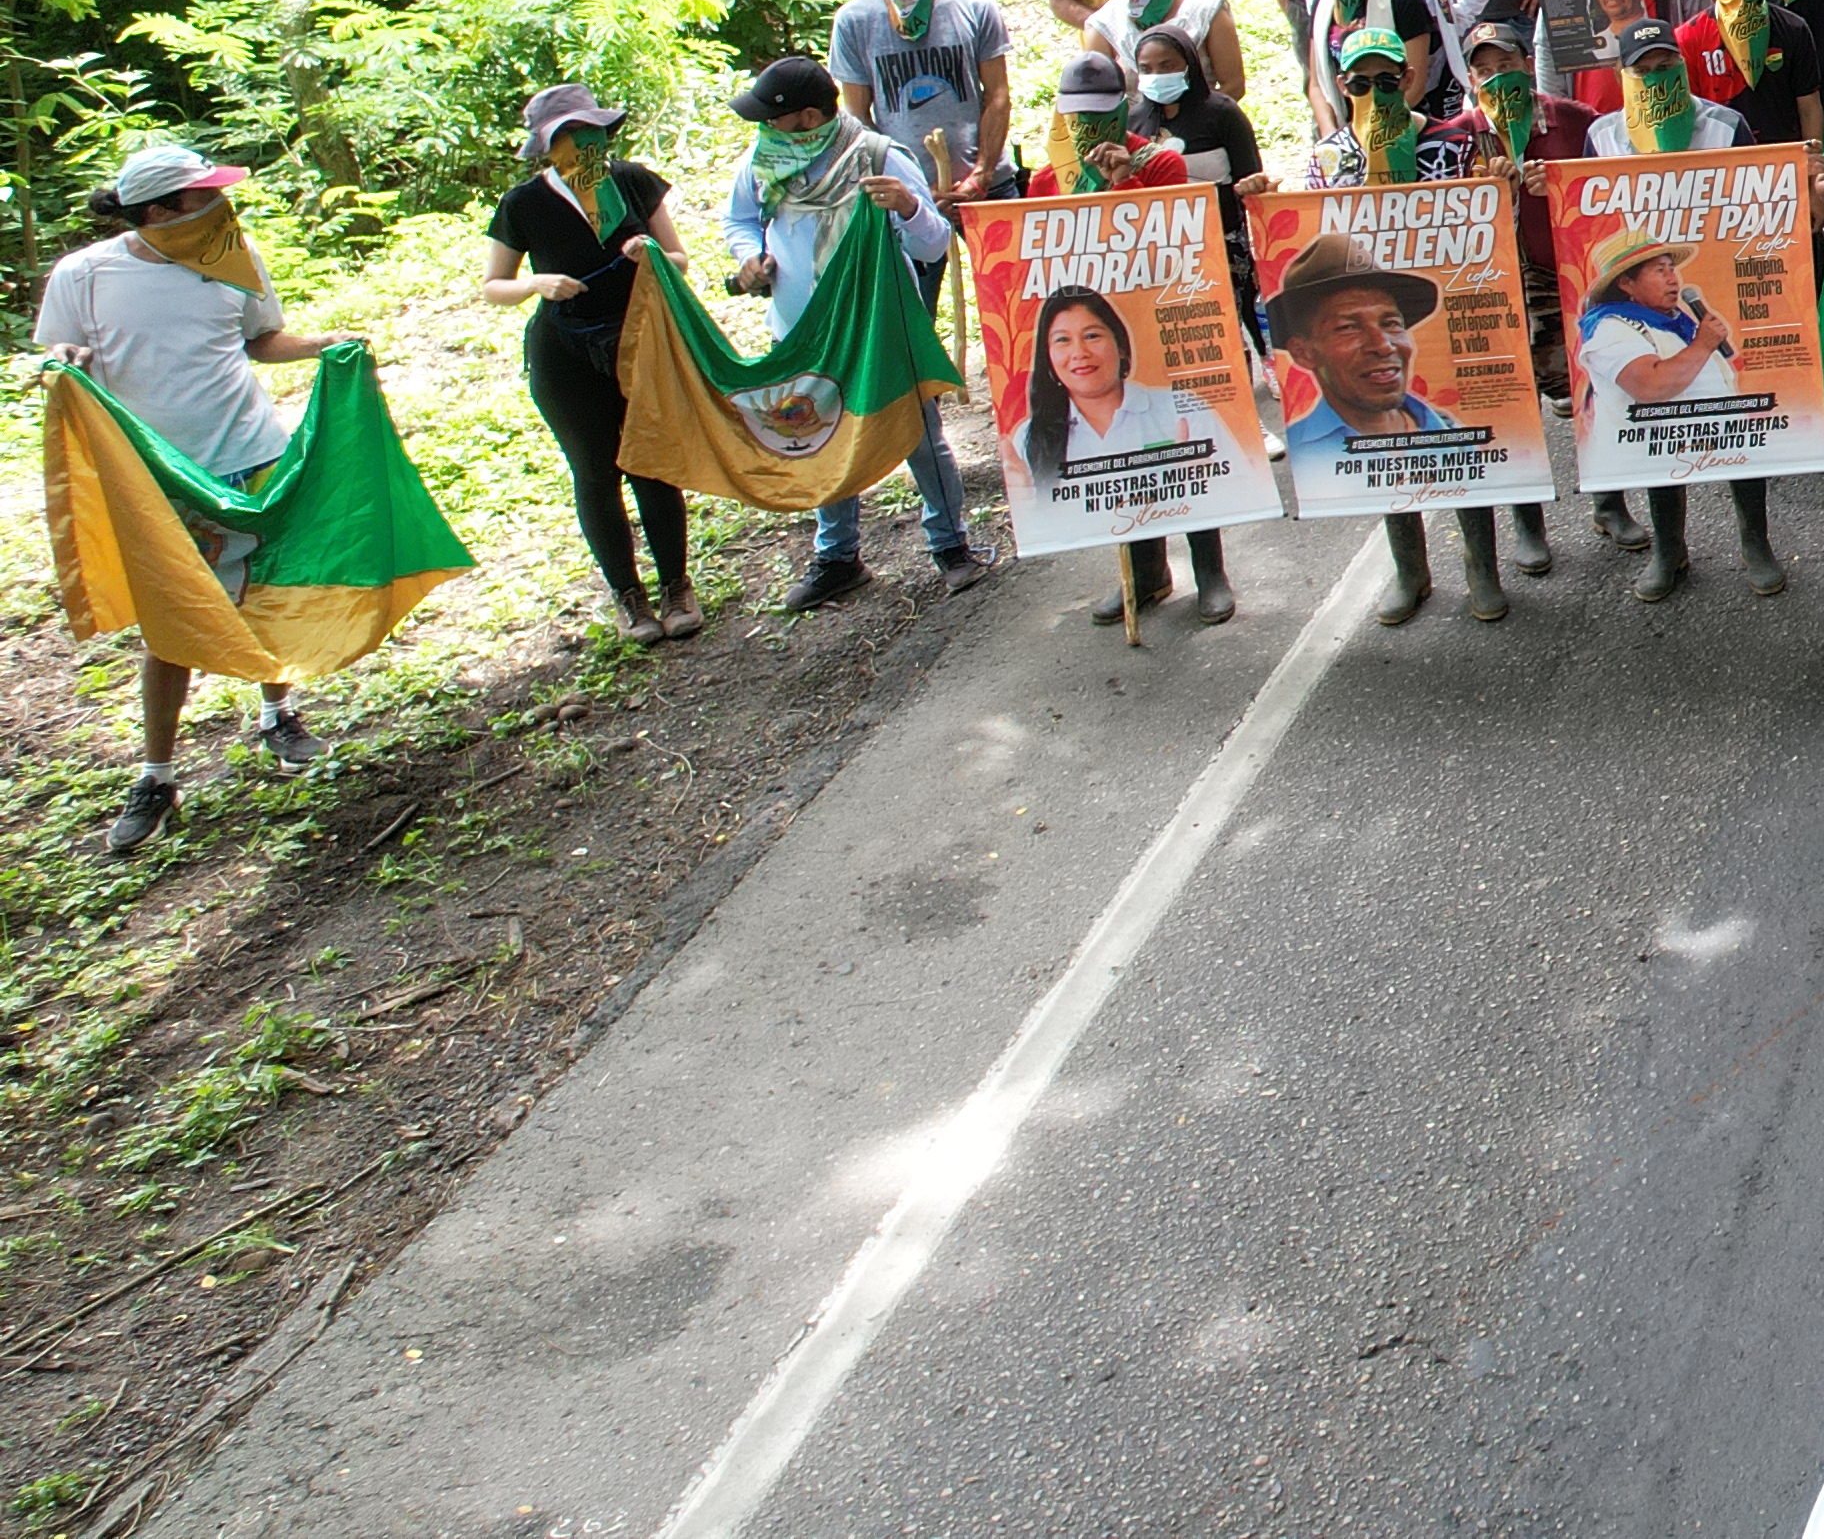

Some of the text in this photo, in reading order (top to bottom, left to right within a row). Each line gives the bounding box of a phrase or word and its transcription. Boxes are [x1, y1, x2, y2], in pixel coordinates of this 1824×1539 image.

[1701, 49, 1727, 77] 10
[875, 43, 967, 113] NEW YORK
[1579, 162, 1798, 217] CARMELINA
[1320, 184, 1499, 235] NARCISO
[1020, 196, 1207, 260] EDILSAN
[1623, 199, 1798, 247] YULE PAVI
[1346, 215, 1495, 273] BELEÑO
[1021, 243, 1205, 300] ANDRADE
[1444, 289, 1513, 313] campesino,
[1737, 279, 1783, 302] mayora
[1155, 300, 1226, 325] campesina,
[1447, 311, 1520, 334] defensor de
[1739, 301, 1770, 322] Nasa
[1159, 322, 1225, 345] defensora
[1451, 335, 1490, 355] la vida
[1742, 333, 1800, 350] ASESINADA
[1165, 342, 1223, 367] de la vida
[1171, 373, 1232, 392] ASESINADA
[1455, 363, 1515, 379] ASESINADO
[1618, 415, 1789, 444] POR NUESTRAS MUERTAS
[1648, 432, 1767, 457] NI UN MINUTO DE
[1335, 448, 1509, 476] POR NUESTROS MUERTOS
[1052, 461, 1230, 502] POR NUESTRAS MUERTAS
[1367, 465, 1486, 488] NI UN MINUTO DE
[1086, 479, 1208, 513] NI UN MINUTO DE
